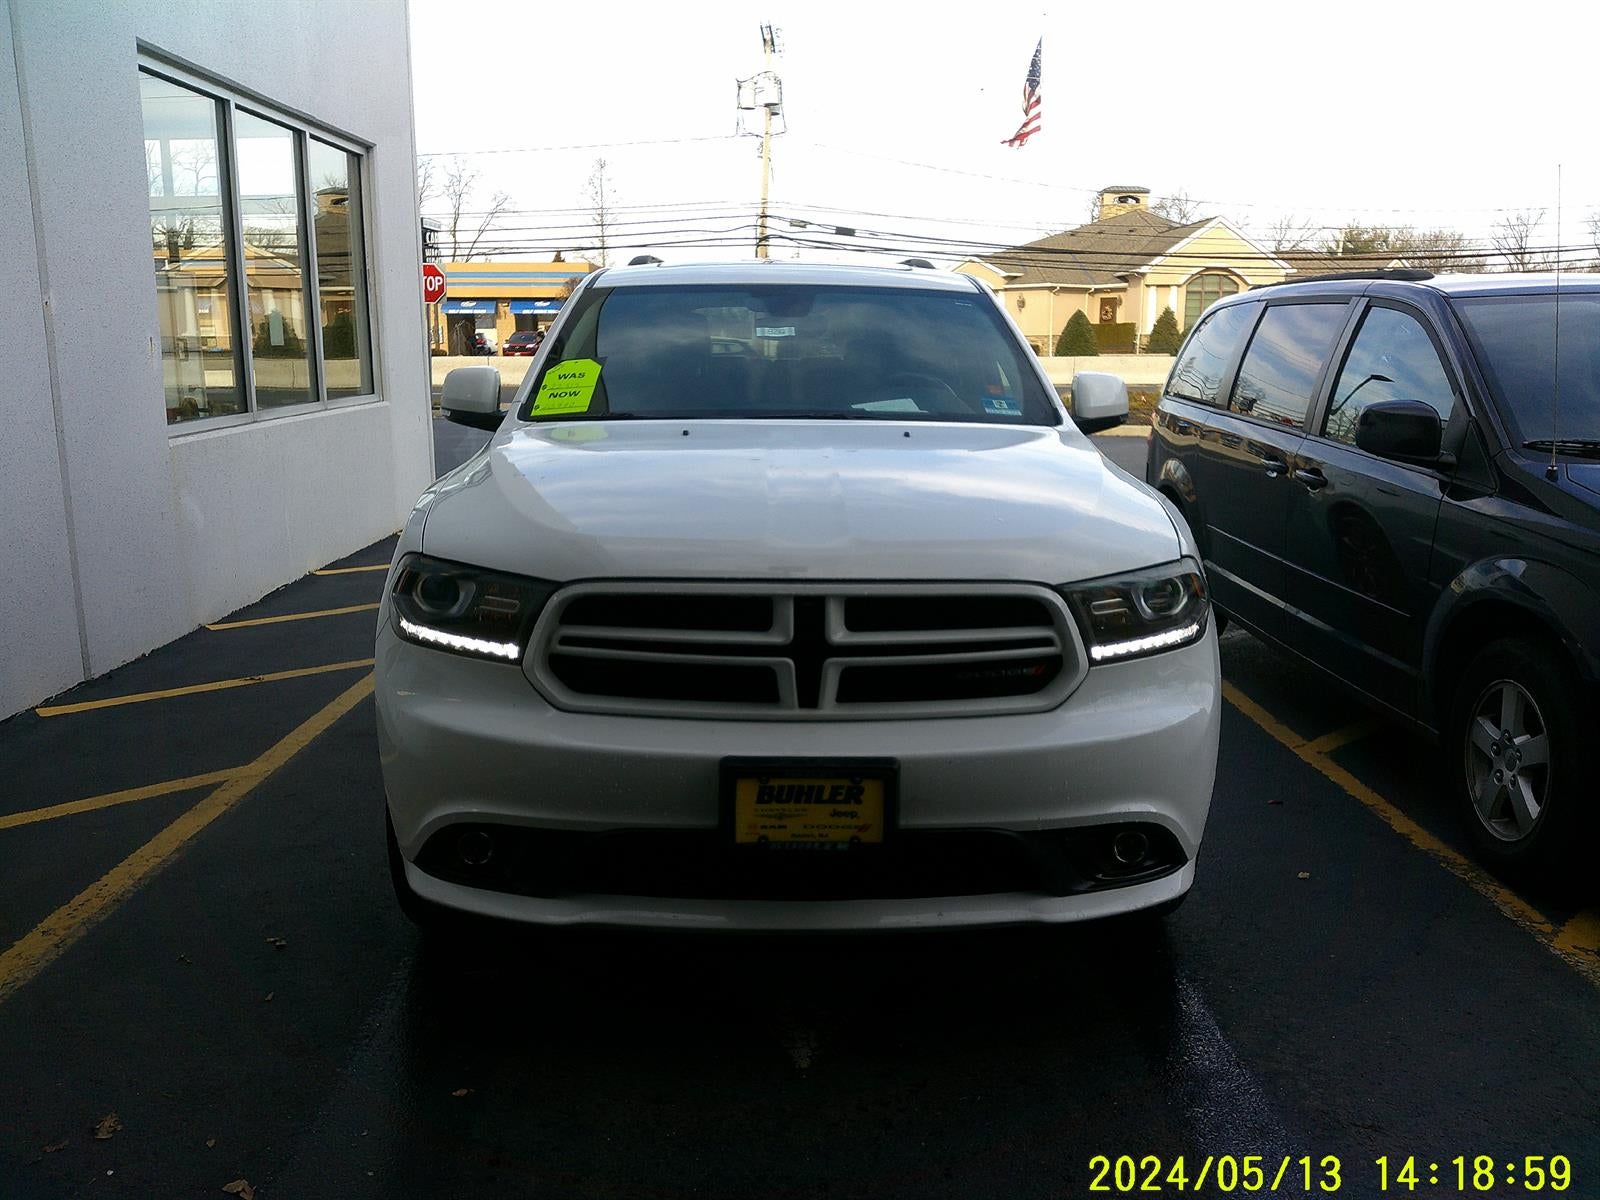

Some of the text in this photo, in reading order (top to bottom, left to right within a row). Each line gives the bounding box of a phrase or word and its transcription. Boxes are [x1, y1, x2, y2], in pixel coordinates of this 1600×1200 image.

[558, 372, 586, 380] WAS
[549, 390, 581, 399] NOW
[755, 785, 865, 805] BUHLER
[829, 808, 859, 819] Jeep
